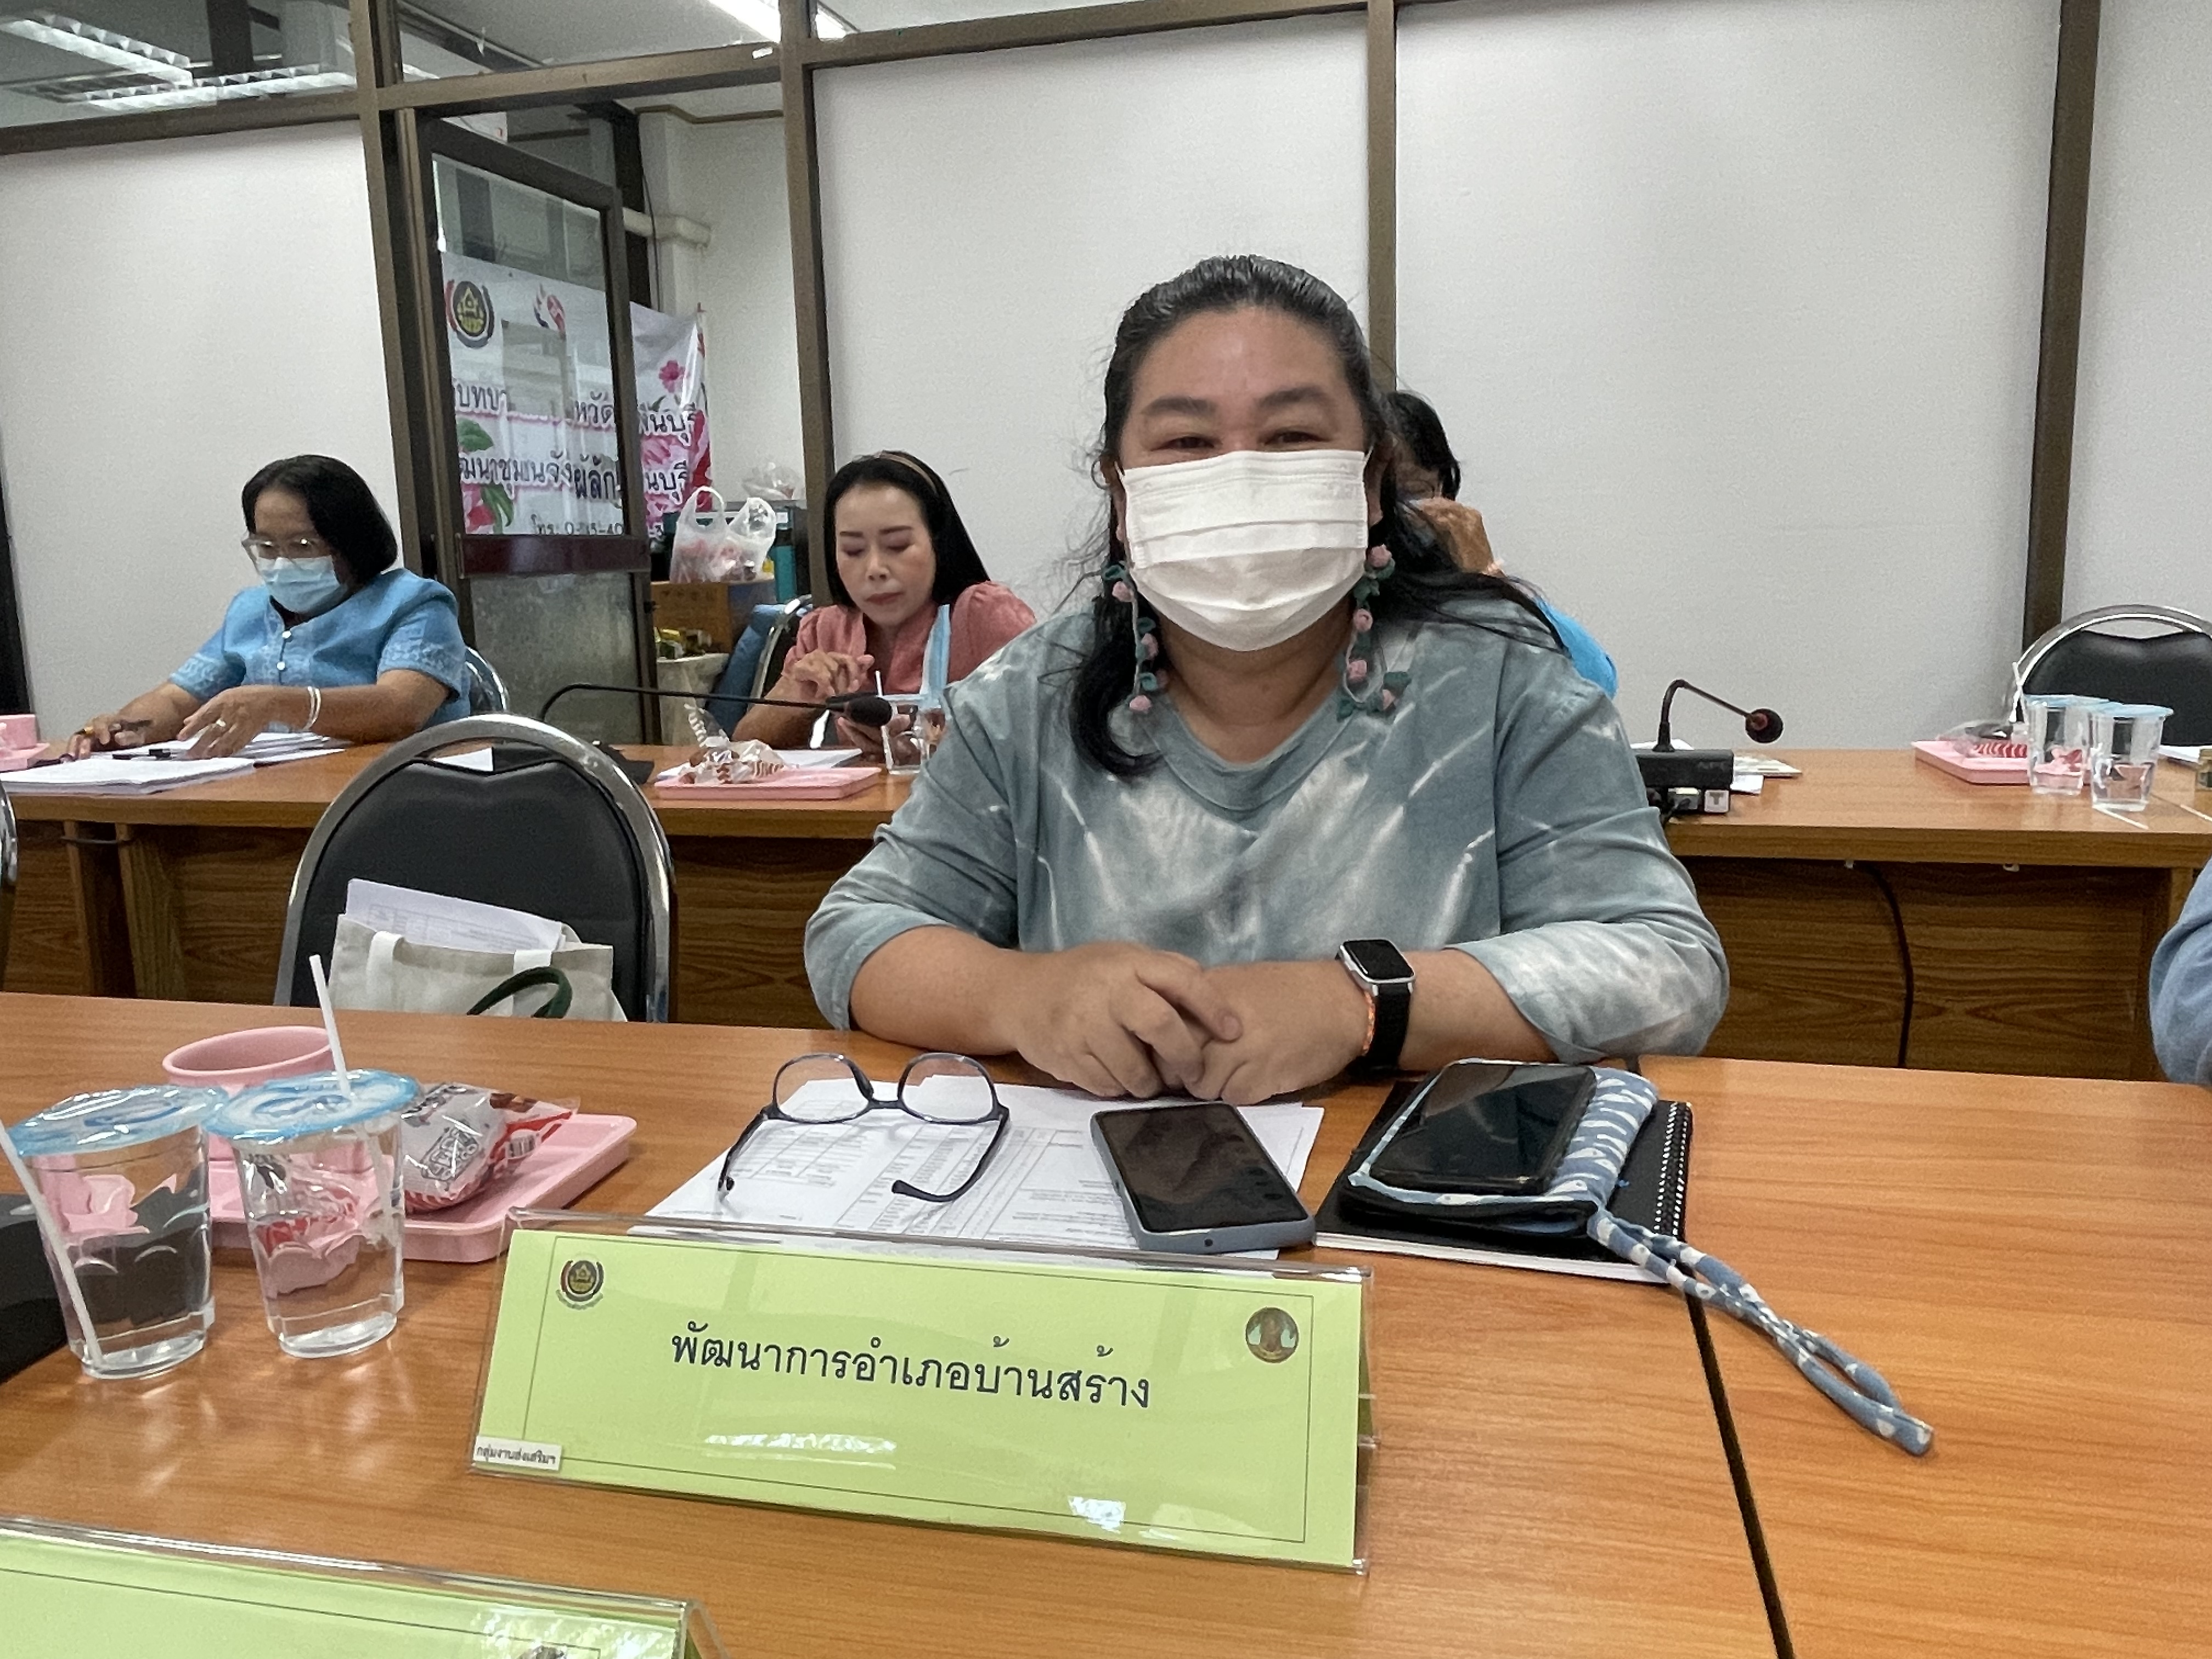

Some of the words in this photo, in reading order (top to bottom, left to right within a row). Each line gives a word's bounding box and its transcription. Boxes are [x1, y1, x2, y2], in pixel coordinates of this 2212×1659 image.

[672, 1321, 1150, 1408] พัฒนาการอำเภอบ้านสร้าง
